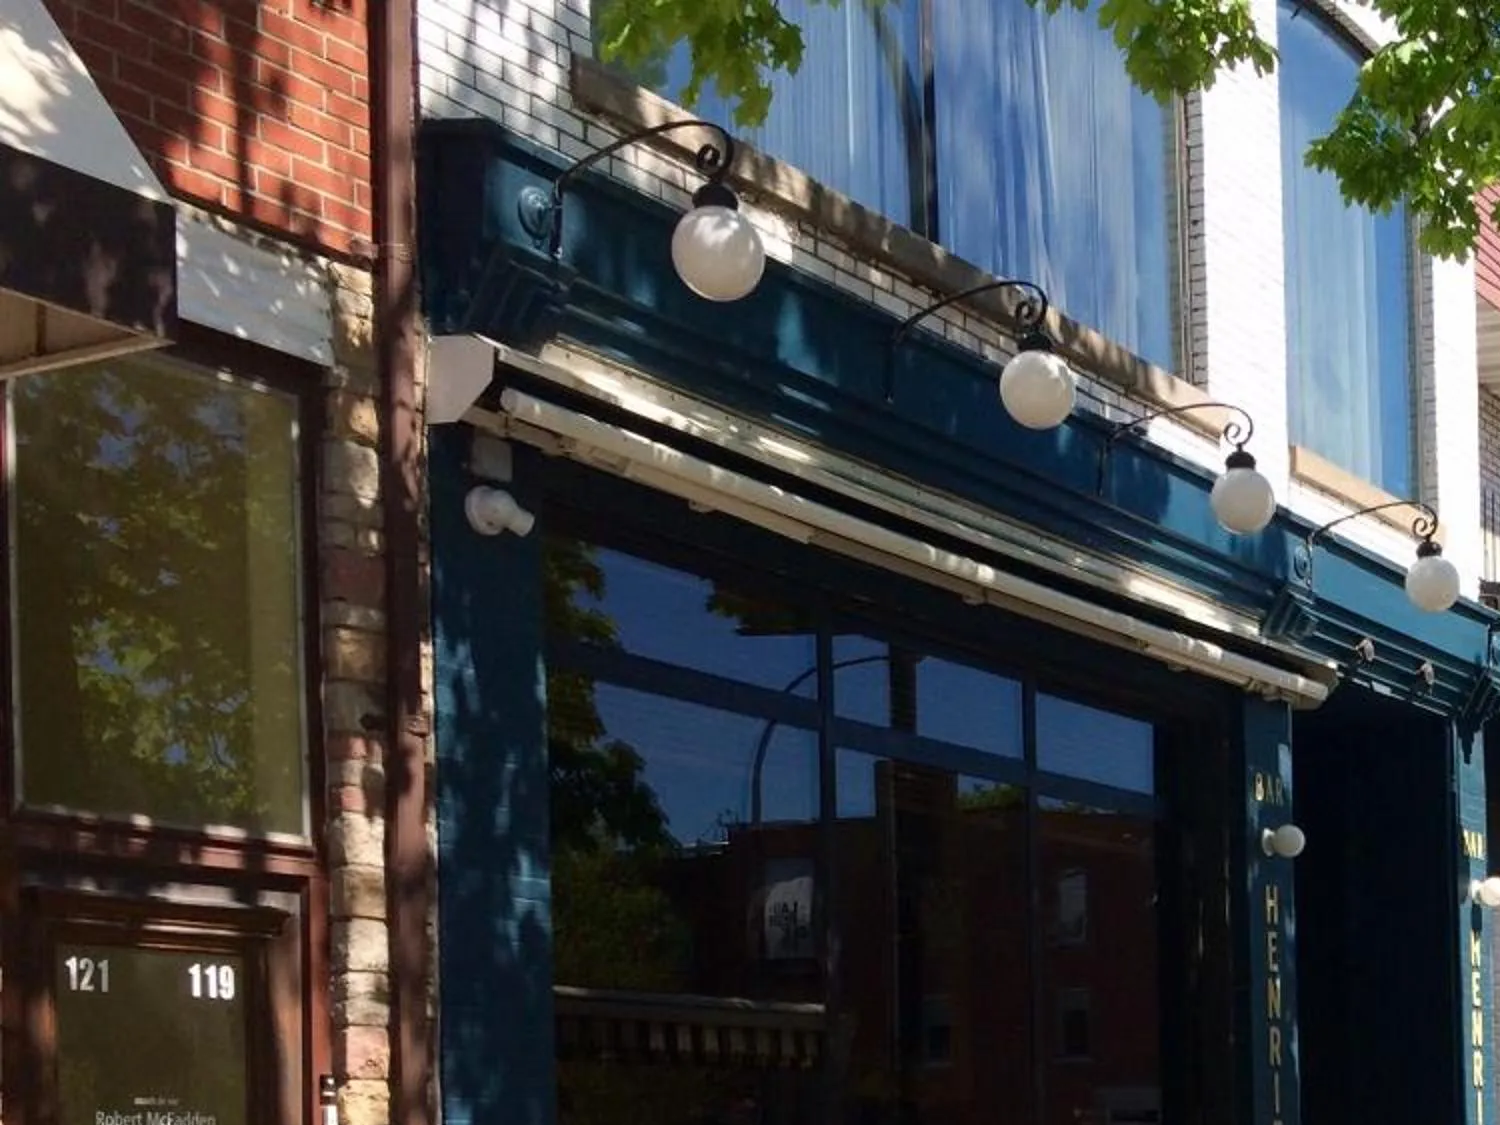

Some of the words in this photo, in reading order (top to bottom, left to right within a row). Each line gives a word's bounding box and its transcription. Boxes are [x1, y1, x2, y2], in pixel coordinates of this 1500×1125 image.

[1254, 771, 1285, 807] BAR
[65, 956, 109, 992] 121
[188, 963, 235, 1000] 119
